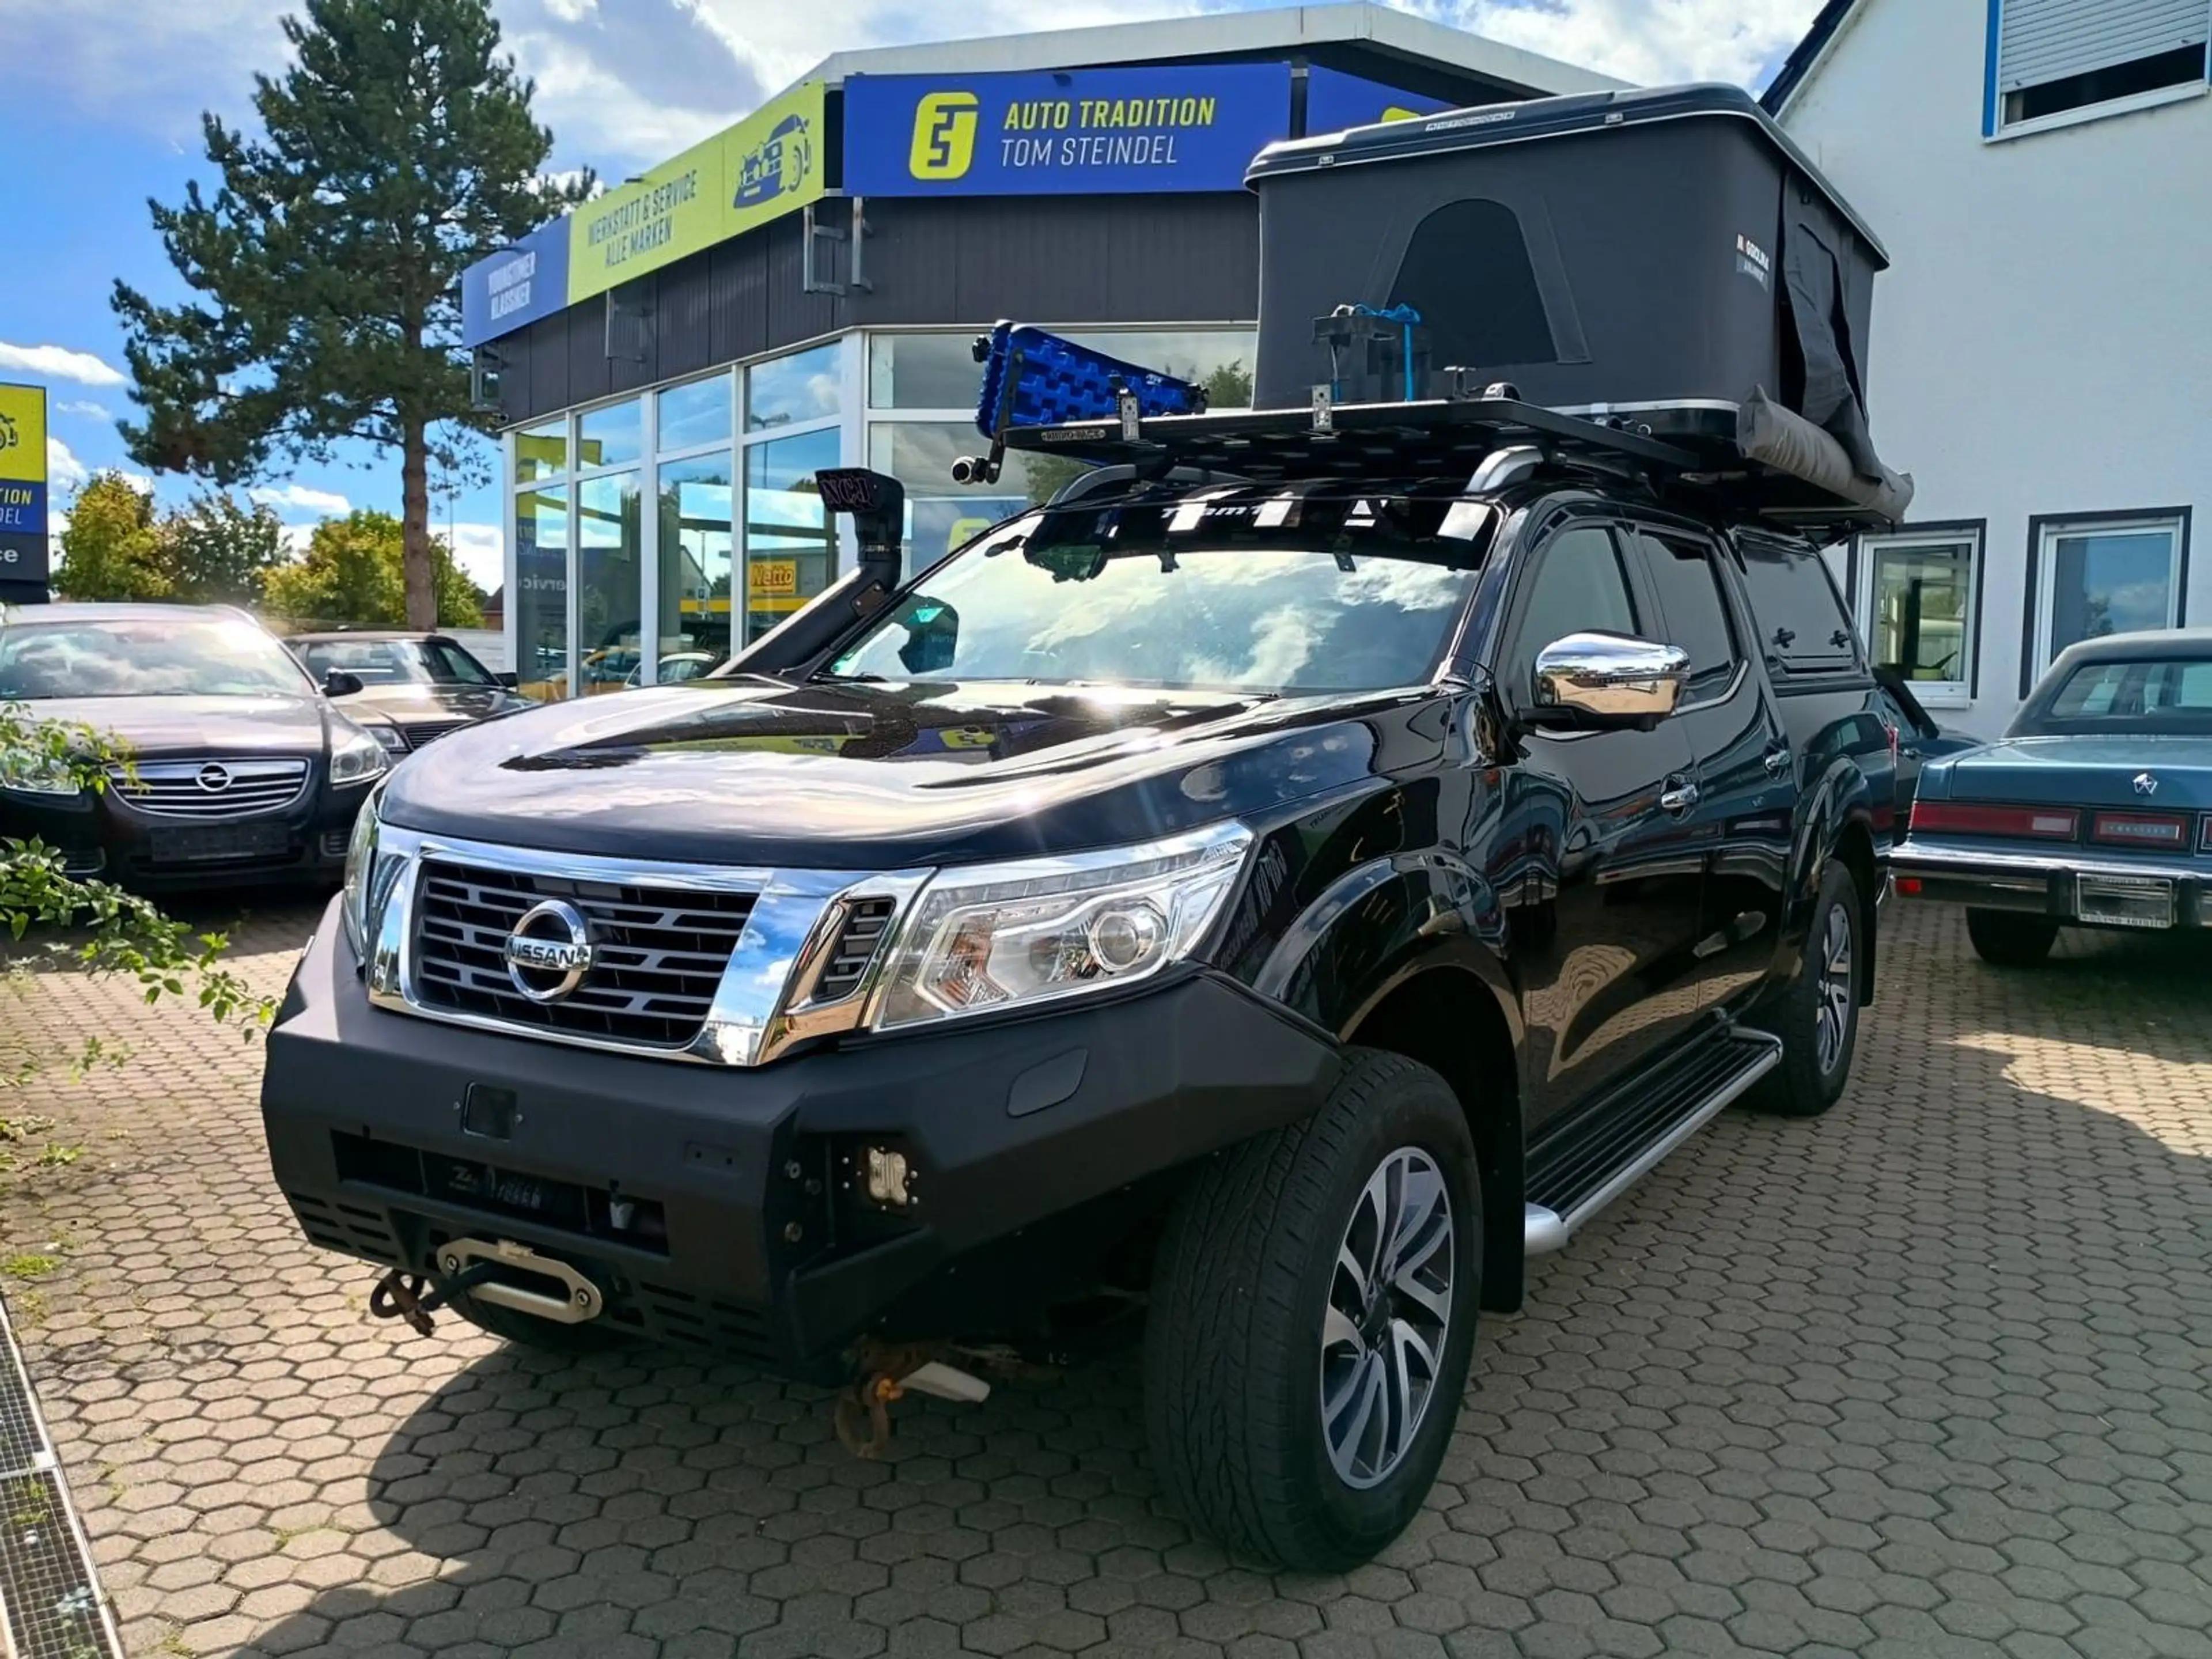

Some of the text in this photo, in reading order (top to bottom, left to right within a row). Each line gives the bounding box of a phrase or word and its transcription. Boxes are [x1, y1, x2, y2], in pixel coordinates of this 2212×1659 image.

[1004, 97, 1215, 130] AUTO TRADITION
[1002, 136, 1177, 167] TOM STEINDEL
[589, 170, 697, 247] WERKSTATT & SERVICE
[606, 214, 673, 267] ALLE MARKEN
[0, 549, 18, 562] e
[751, 564, 794, 586] Netto
[508, 938, 574, 964] NISSAN
